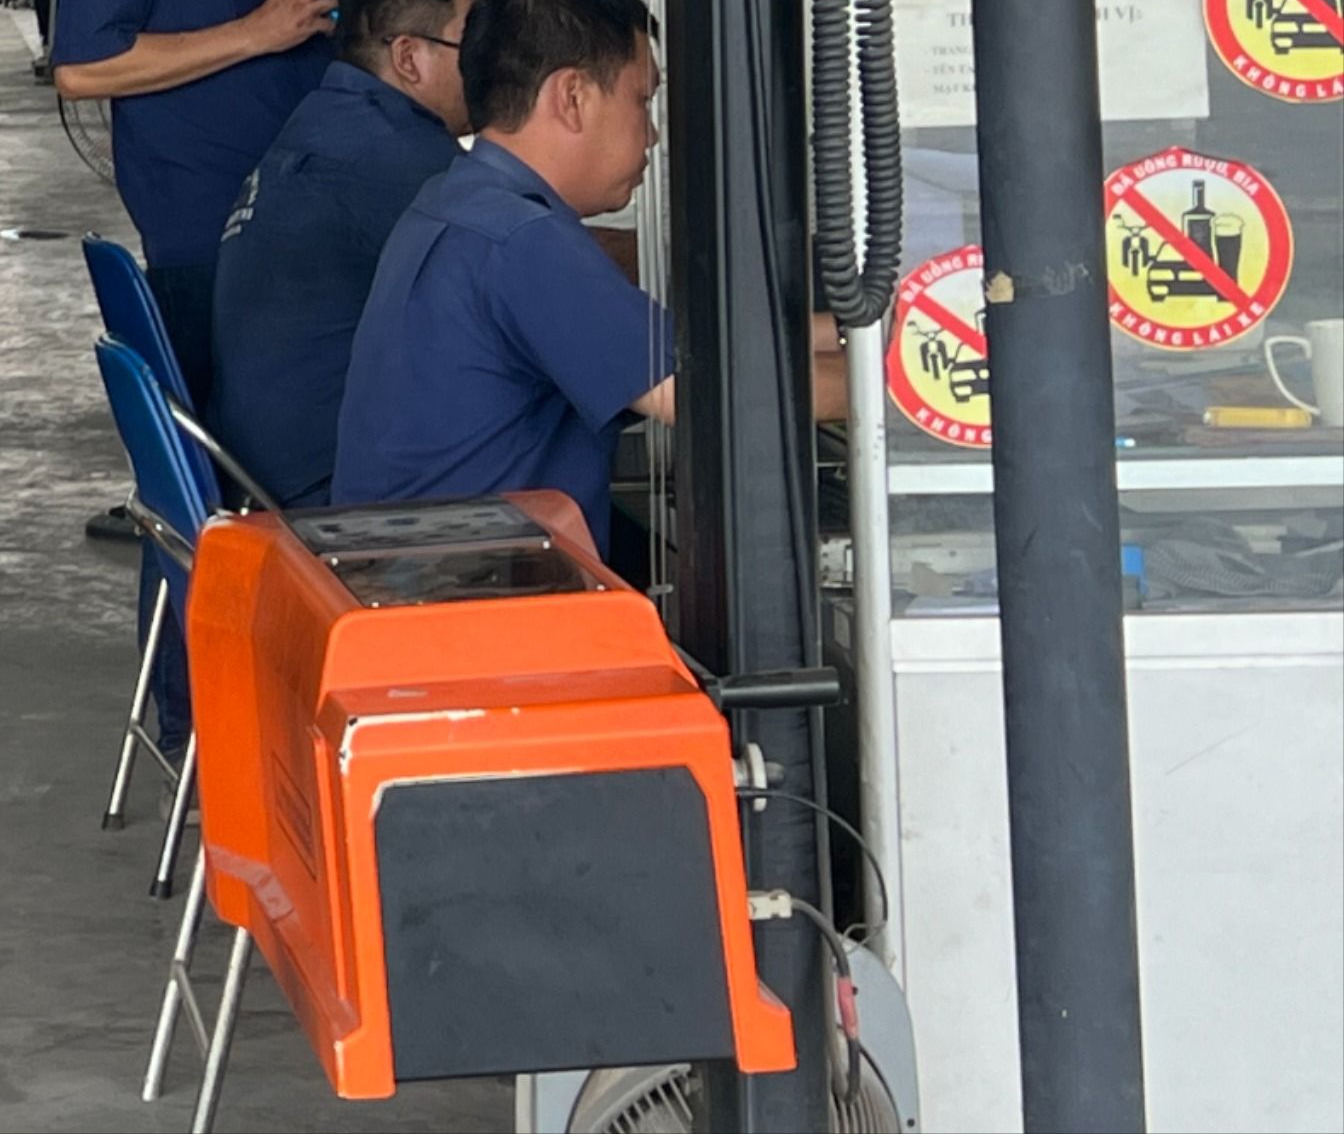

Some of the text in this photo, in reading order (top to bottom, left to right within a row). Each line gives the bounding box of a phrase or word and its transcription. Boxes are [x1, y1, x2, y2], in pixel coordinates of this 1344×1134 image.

[1316, 76, 1344, 98] LÁ
[1232, 170, 1260, 196] BIA
[1237, 301, 1265, 328] XE
